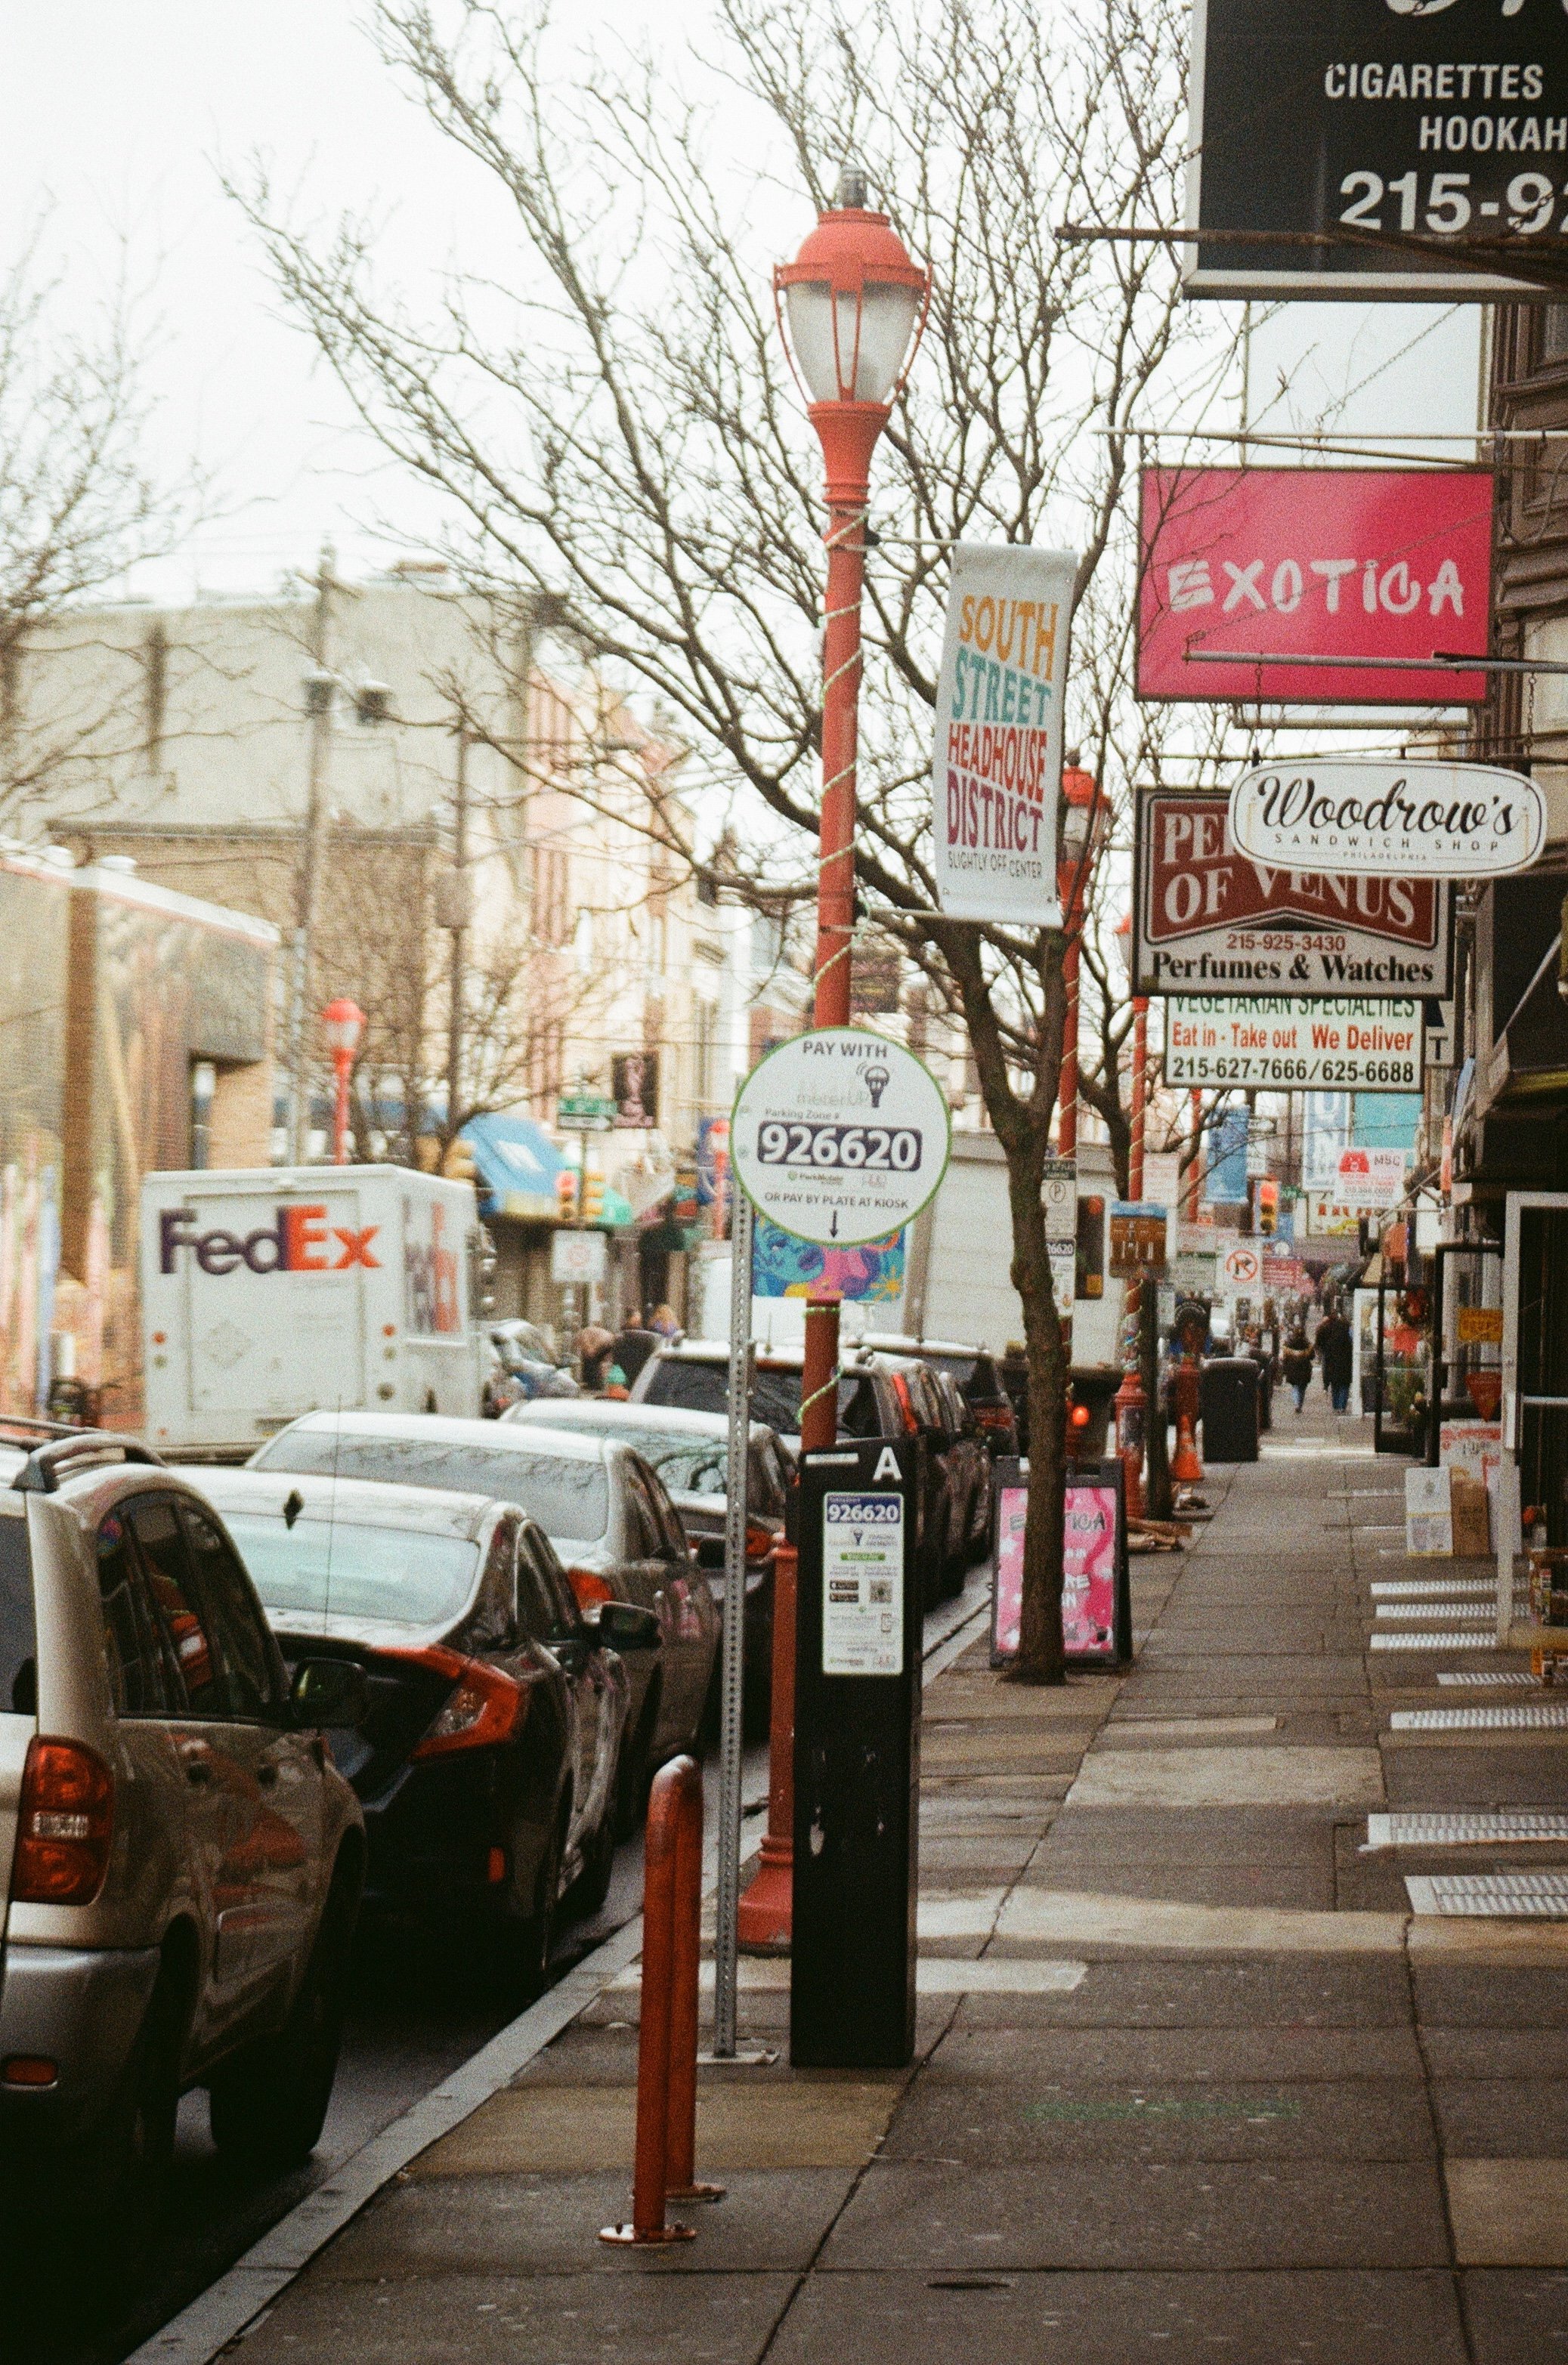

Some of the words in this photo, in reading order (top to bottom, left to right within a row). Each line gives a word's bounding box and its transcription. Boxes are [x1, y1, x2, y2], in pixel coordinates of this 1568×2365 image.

[1324, 63, 1544, 100] CIGARETTES
[1419, 115, 1568, 151] HOOKAH
[1340, 171, 1568, 234] 215-9
[1167, 558, 1464, 617] EXOTICA
[959, 595, 1059, 681] SOUTH
[951, 645, 1053, 725] STREET
[947, 722, 1047, 803] HEADHOUSE
[946, 767, 1044, 852] DISTRICT
[1257, 775, 1519, 836] Woodrow's
[1275, 833, 1410, 849] SANDWICH
[1436, 839, 1498, 852] SHOP
[1343, 851, 1428, 861] PHILADELPHIA
[948, 850, 988, 871] SLIGHTLY
[990, 853, 1007, 873] OFF
[1008, 858, 1043, 880] CENTER
[1164, 867, 1234, 924] OF
[1227, 933, 1345, 951] 215-925-3430
[1152, 951, 1281, 980] Perfumes
[1289, 953, 1310, 980] &
[1320, 954, 1433, 982] Watches
[1174, 997, 1291, 1015] VEGETARIAN
[803, 1040, 835, 1056] PAY
[841, 1042, 888, 1059] WITH
[1172, 1022, 1198, 1047] Eat
[1202, 1023, 1217, 1046] in
[1231, 1022, 1267, 1049] Take
[1273, 1028, 1297, 1050] out
[1311, 1025, 1340, 1050] We
[1347, 1024, 1413, 1051] Deliver
[1173, 1056, 1414, 1084] 215-627-7666/625-6688
[765, 1108, 803, 1120] Parking
[806, 1109, 831, 1120] Zone
[762, 1123, 918, 1170] 926620
[765, 1192, 781, 1202] OR
[783, 1192, 803, 1204] PAY
[806, 1193, 819, 1204] BY
[823, 1195, 855, 1207] PLATE
[858, 1196, 872, 1207] AT
[875, 1197, 909, 1209] KIOSK
[159, 1204, 382, 1275] FedEx
[873, 1445, 903, 1482] A
[828, 1503, 900, 1522] 926620
